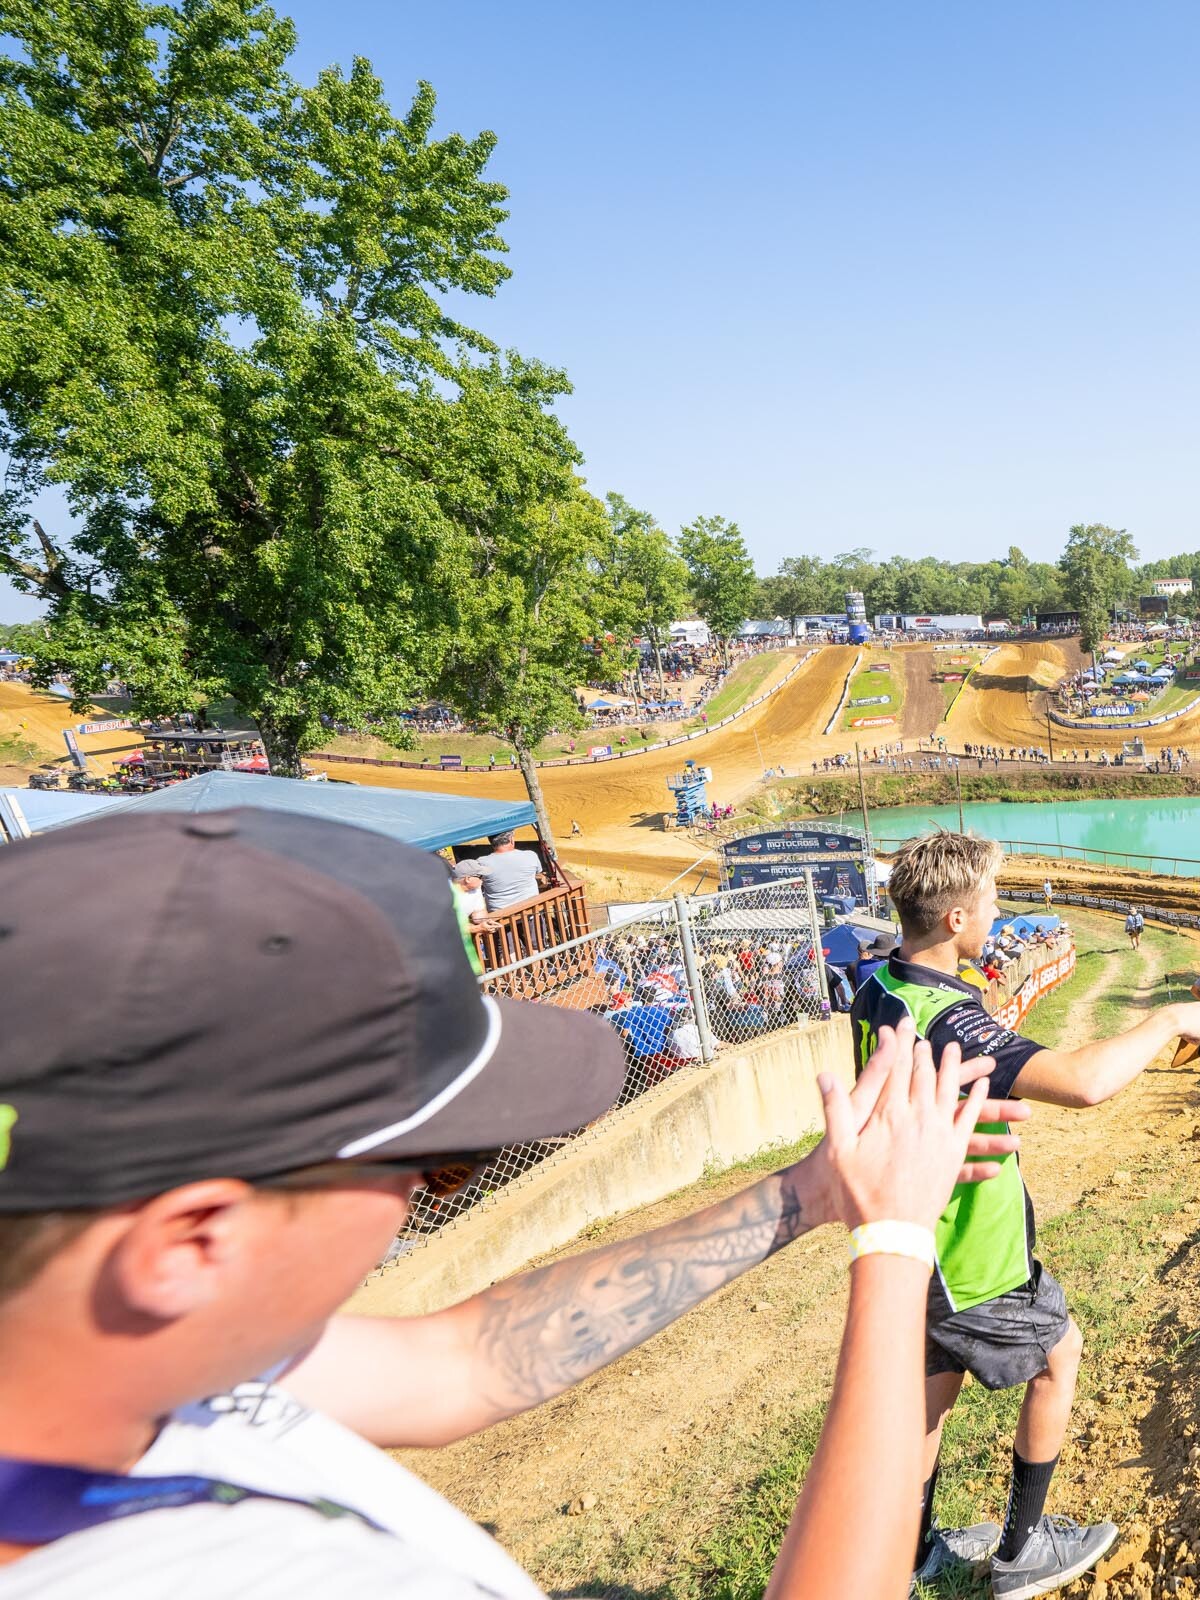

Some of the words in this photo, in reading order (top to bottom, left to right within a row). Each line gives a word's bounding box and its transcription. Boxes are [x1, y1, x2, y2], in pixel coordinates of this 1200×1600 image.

[1103, 707, 1130, 716] YAMAHA
[863, 718, 894, 726] HONDA
[766, 839, 820, 848] MOTOCROSS
[770, 866, 820, 874] MOTOCRSS
[953, 1013, 985, 1030] DUNLOP
[963, 1017, 990, 1031] SCOTT
